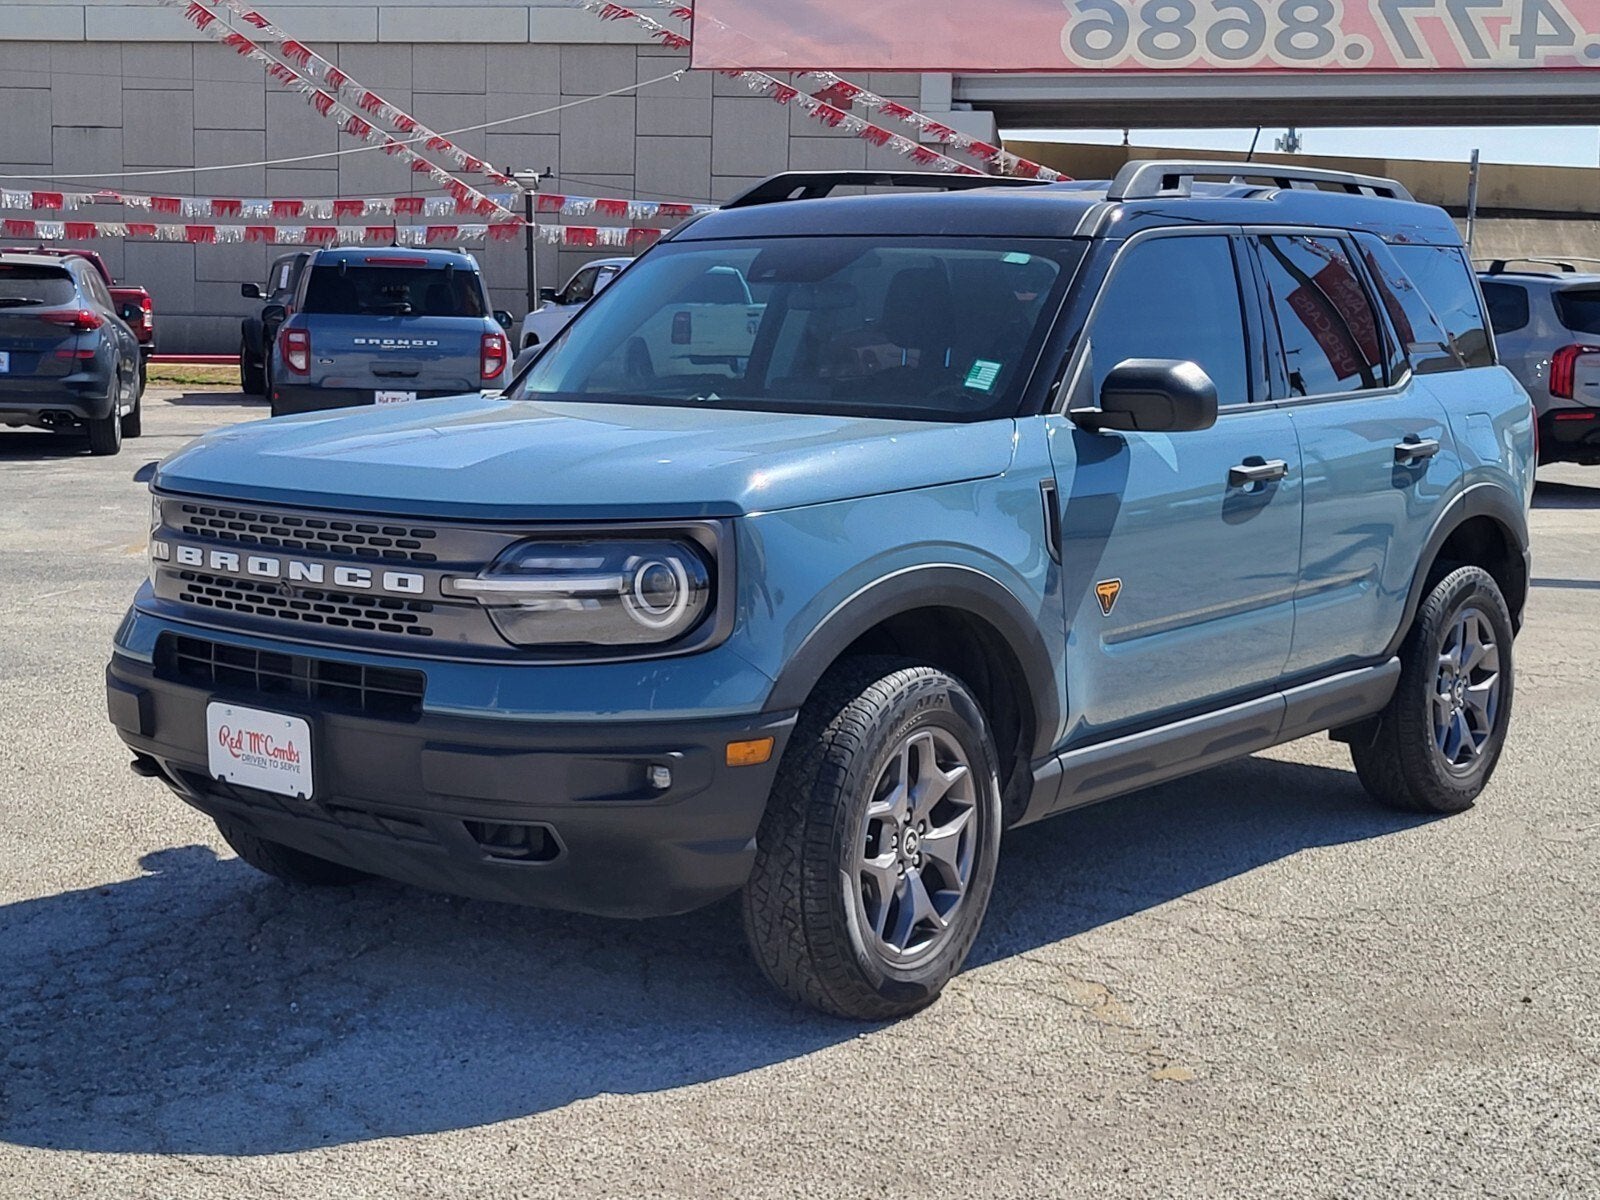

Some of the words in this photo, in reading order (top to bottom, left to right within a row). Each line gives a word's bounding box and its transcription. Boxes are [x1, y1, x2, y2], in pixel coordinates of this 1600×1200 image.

[353, 337, 439, 346] BRONCO
[176, 545, 425, 594] BRONCO
[218, 724, 244, 758] Red
[244, 730, 301, 764] McCombs
[241, 753, 268, 767] DRIVEN
[269, 758, 280, 769] TO
[280, 760, 301, 774] SERVE
